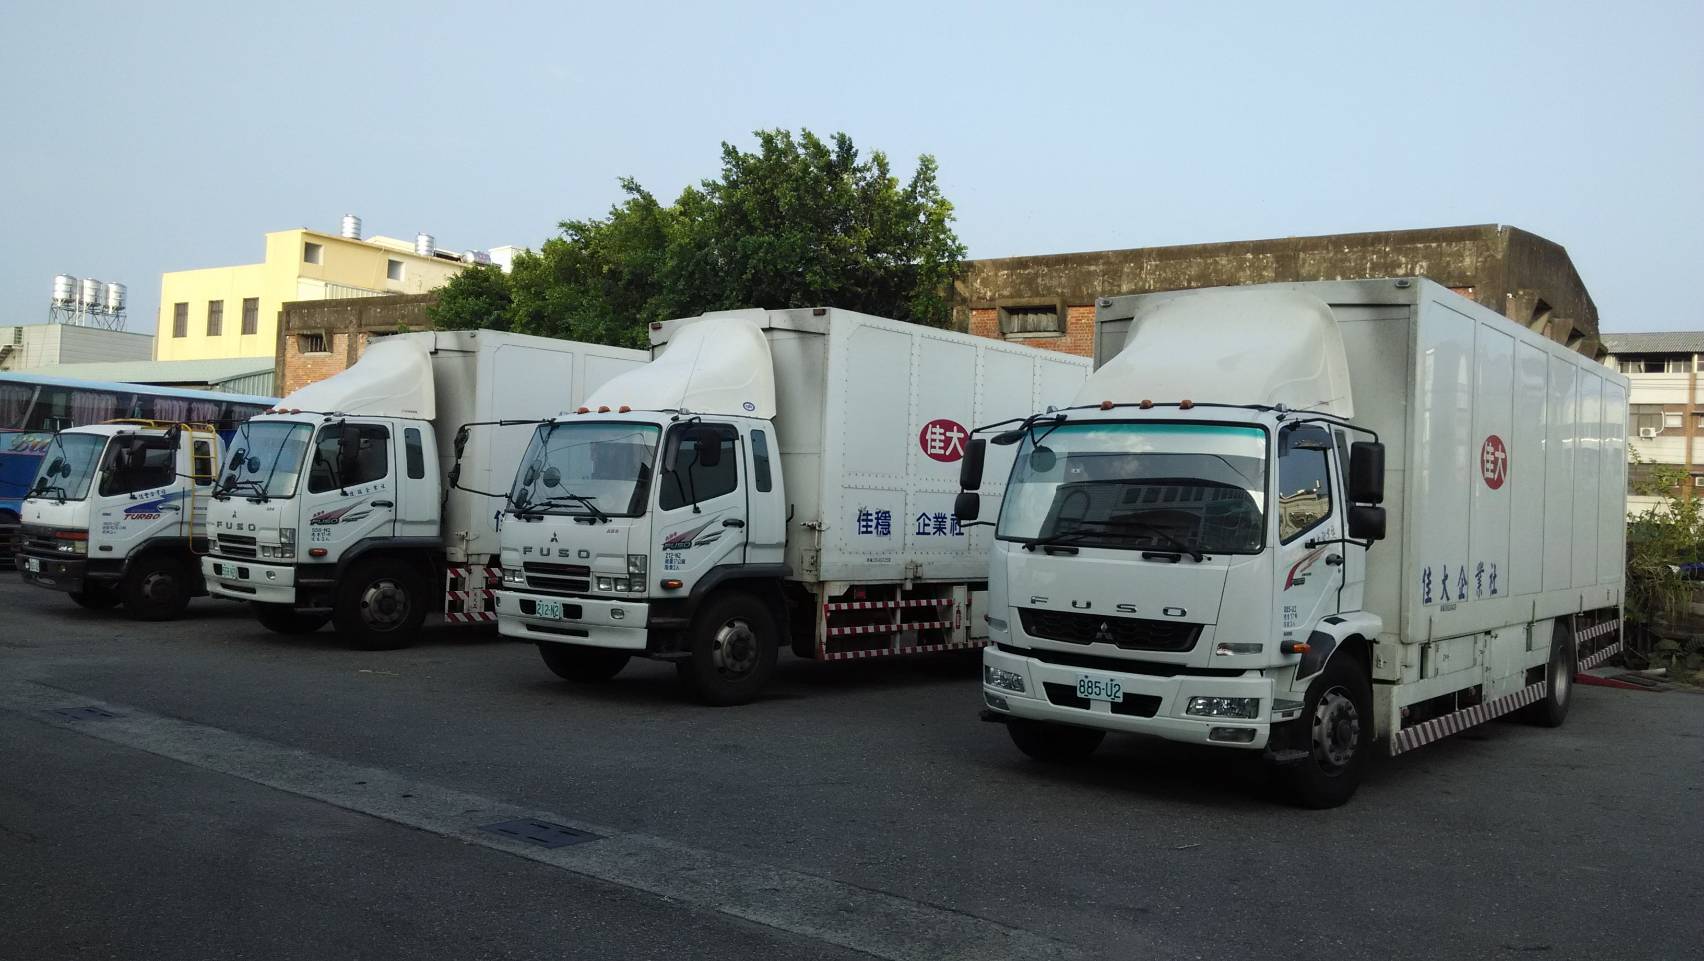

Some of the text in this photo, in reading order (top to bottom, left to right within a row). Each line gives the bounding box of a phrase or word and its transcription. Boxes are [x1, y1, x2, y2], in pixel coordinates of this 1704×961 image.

[925, 424, 965, 457] 佳大
[1484, 441, 1505, 481] 佳大
[217, 521, 256, 532] FUSO
[857, 510, 965, 537] 佳穩 企業社
[523, 546, 590, 559] FUSO
[1422, 561, 1498, 605] 佳大企業社
[537, 603, 559, 617] 212-N2
[1031, 596, 1187, 617] FUSO
[1078, 679, 1121, 700] 885-U2
